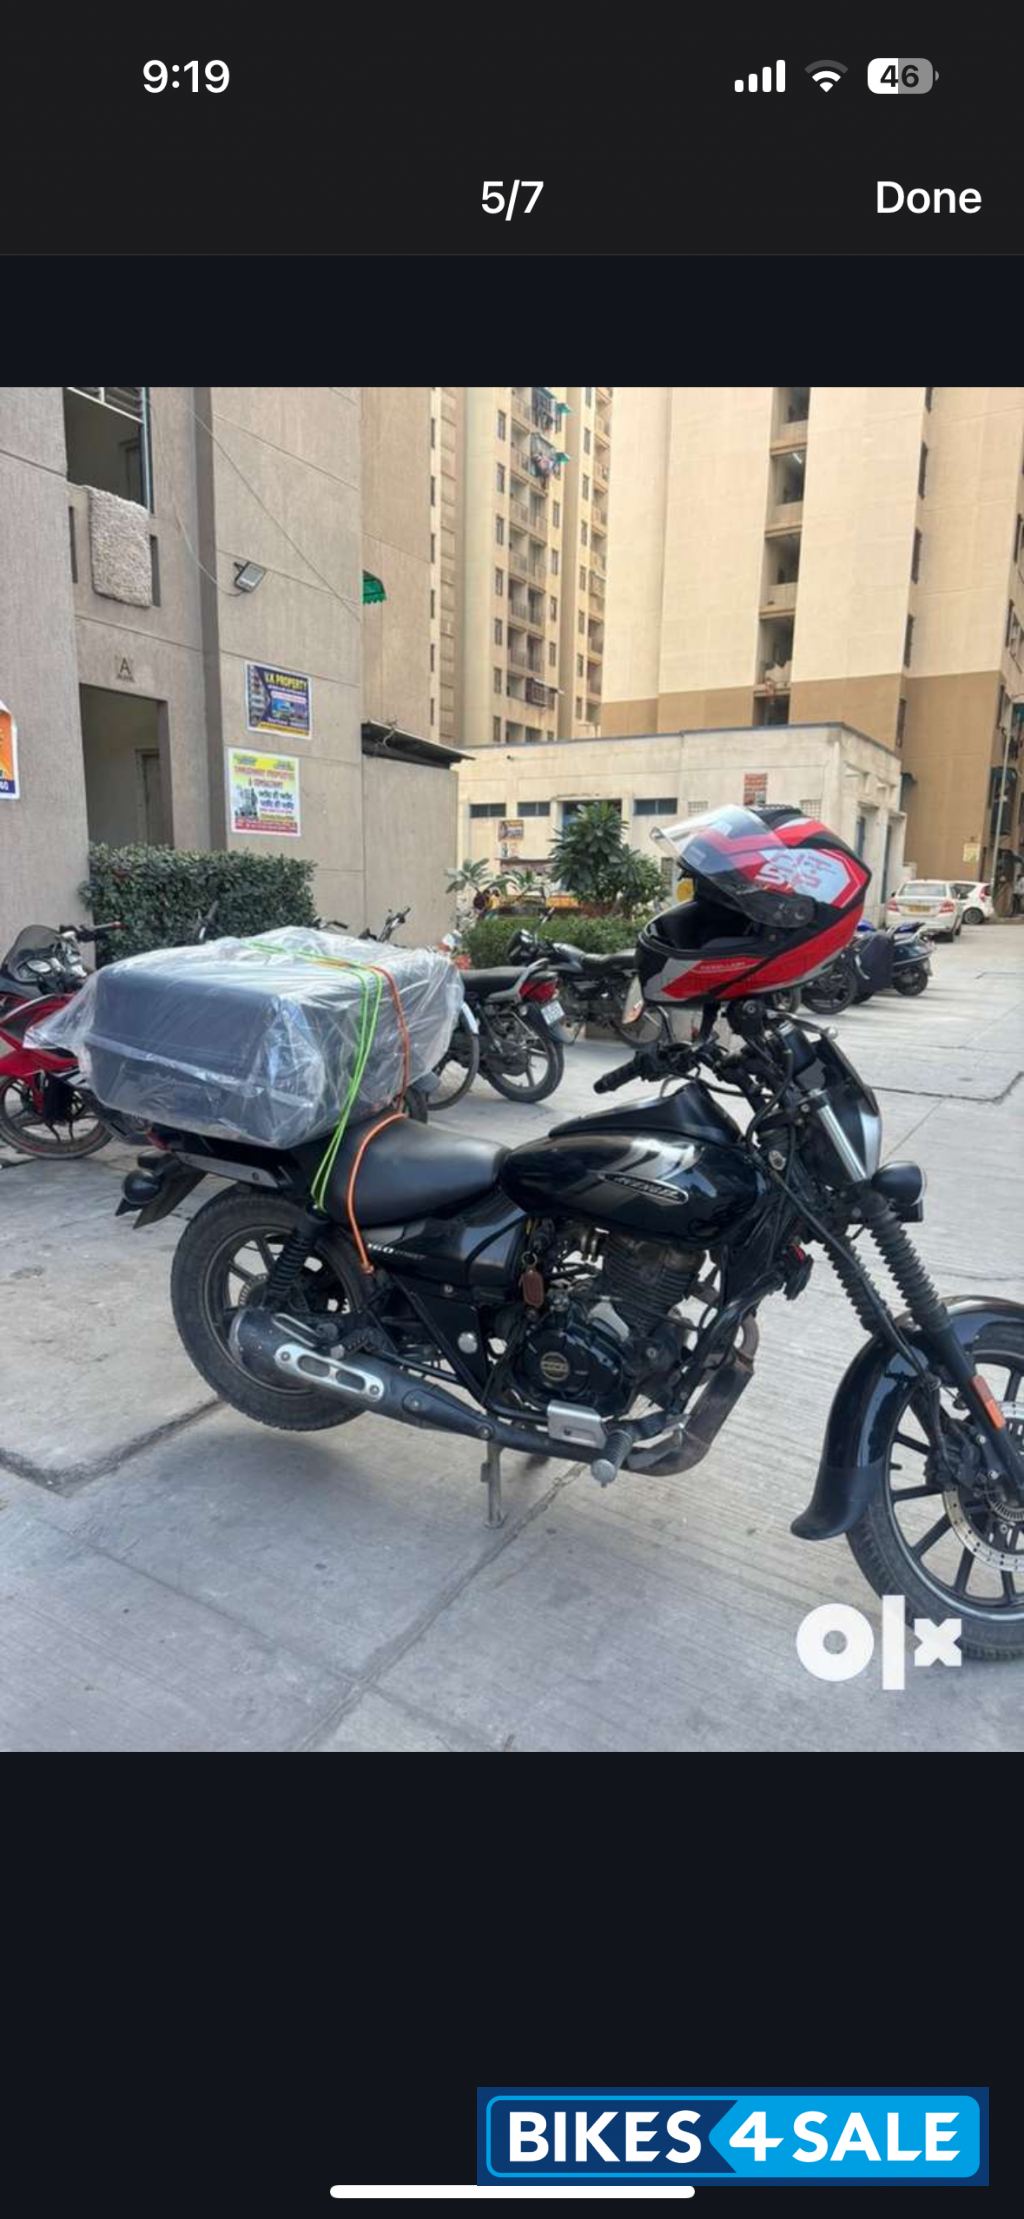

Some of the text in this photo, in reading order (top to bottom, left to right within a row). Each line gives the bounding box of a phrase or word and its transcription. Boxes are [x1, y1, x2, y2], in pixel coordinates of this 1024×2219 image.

[142, 59, 230, 94] 9:19
[880, 64, 920, 88] 46
[481, 179, 544, 222] 5/7
[876, 180, 982, 214] Done
